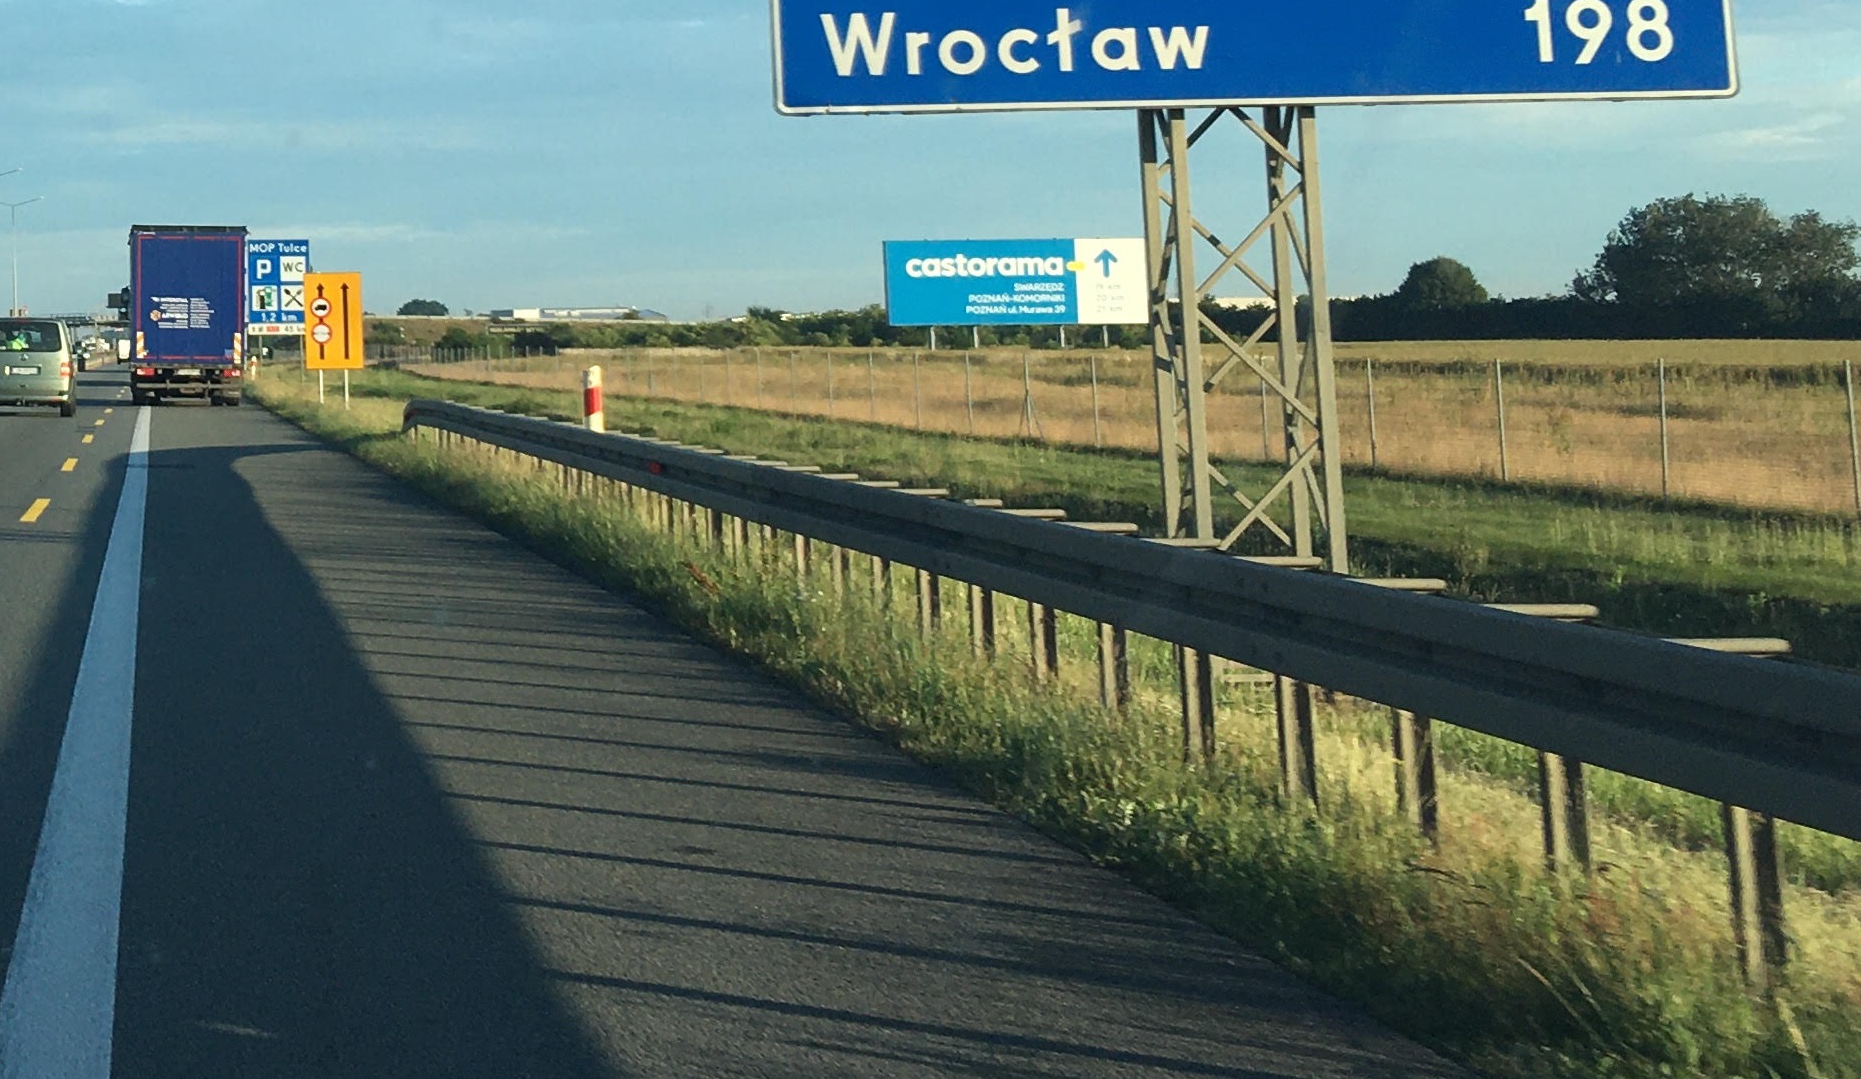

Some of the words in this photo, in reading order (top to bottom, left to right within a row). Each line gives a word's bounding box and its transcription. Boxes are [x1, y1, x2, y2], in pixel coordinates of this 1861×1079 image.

[820, 8, 1210, 77] Wrocław
[249, 243, 275, 253] MOP
[278, 243, 307, 253] Tulce
[256, 259, 272, 280] P
[282, 262, 303, 272] WC
[905, 253, 1064, 278] castorama
[965, 304, 1007, 314] POZNAŃ
[281, 312, 297, 321] km
